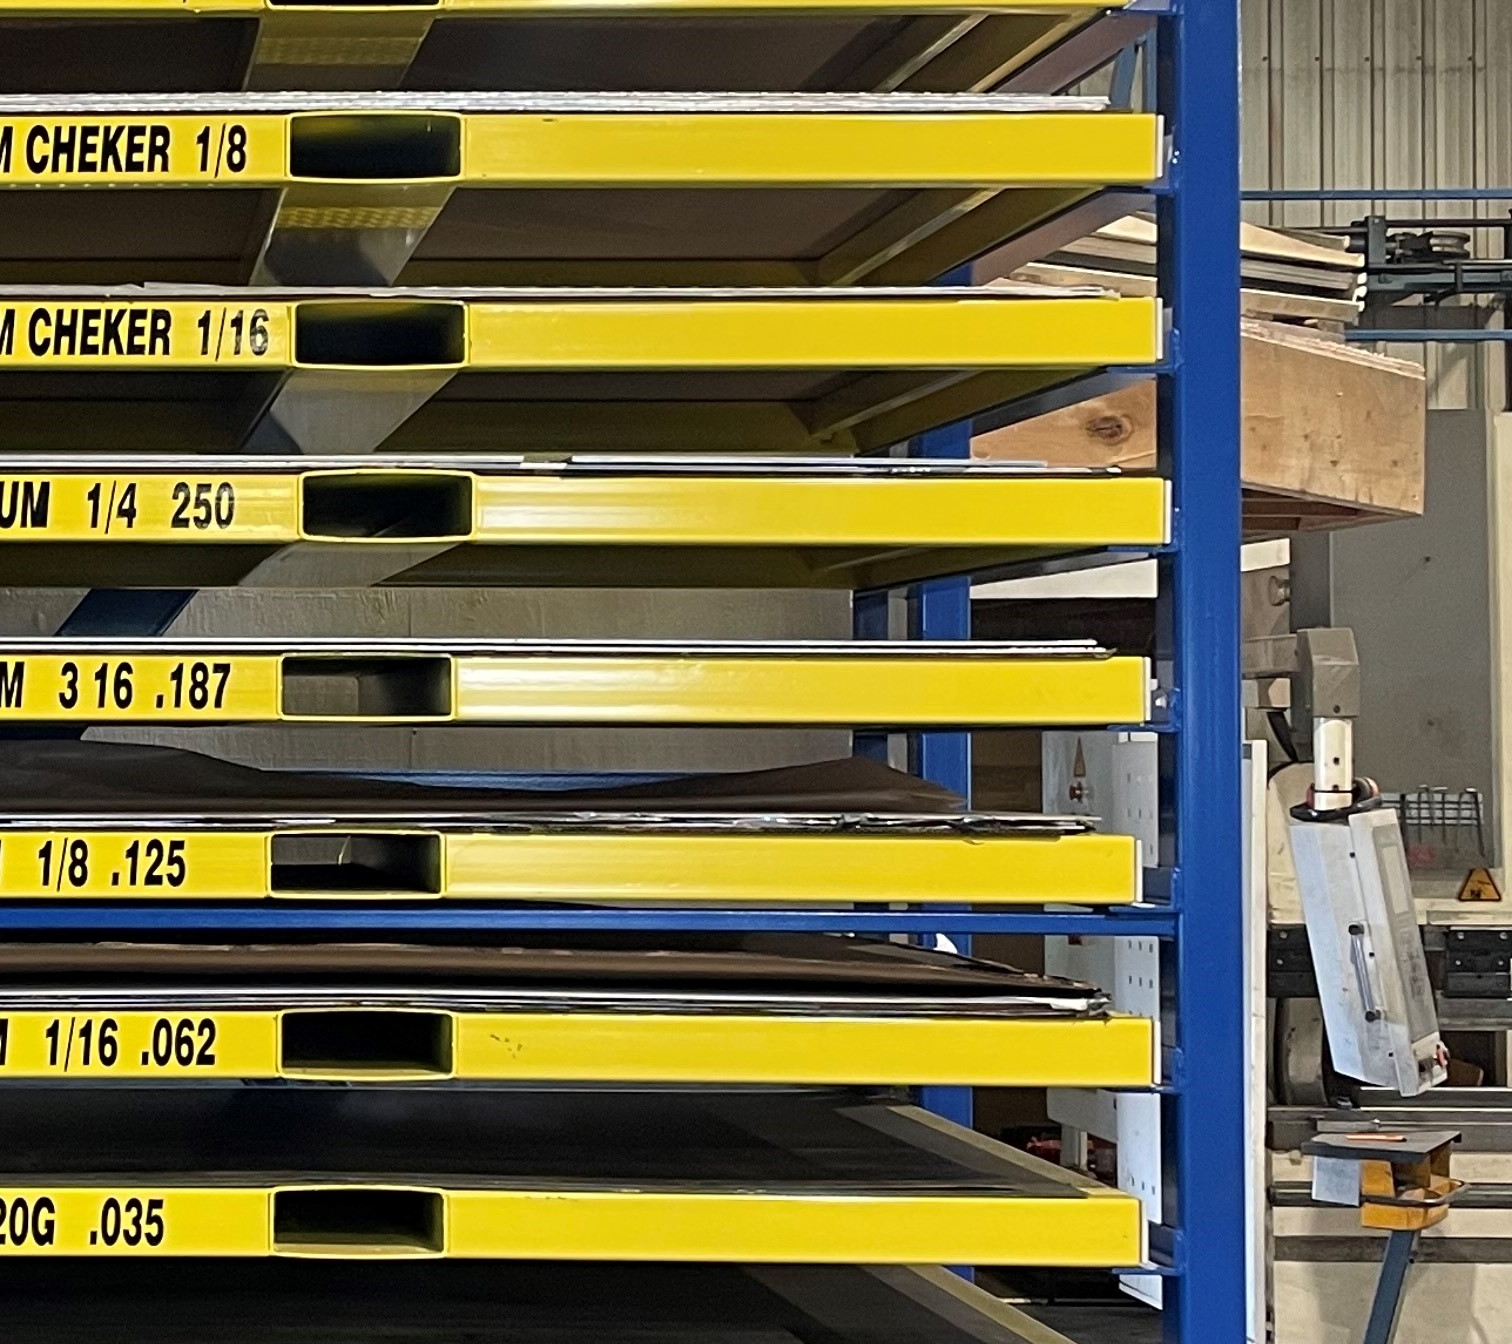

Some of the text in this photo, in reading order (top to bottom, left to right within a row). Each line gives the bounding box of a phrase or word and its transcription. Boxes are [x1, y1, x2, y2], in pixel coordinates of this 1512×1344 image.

[25, 123, 171, 175] CHEKER
[195, 122, 248, 179] 1/8
[26, 307, 172, 358] CHEKER
[196, 307, 271, 362] 1/16
[86, 480, 138, 535] 1/4
[170, 481, 235, 530] 250
[155, 661, 232, 710] .187
[37, 836, 89, 893] 1/8
[110, 839, 187, 888] .125
[44, 1016, 119, 1073] 1/16
[139, 1017, 217, 1067] .062
[88, 1197, 165, 1248] .035
